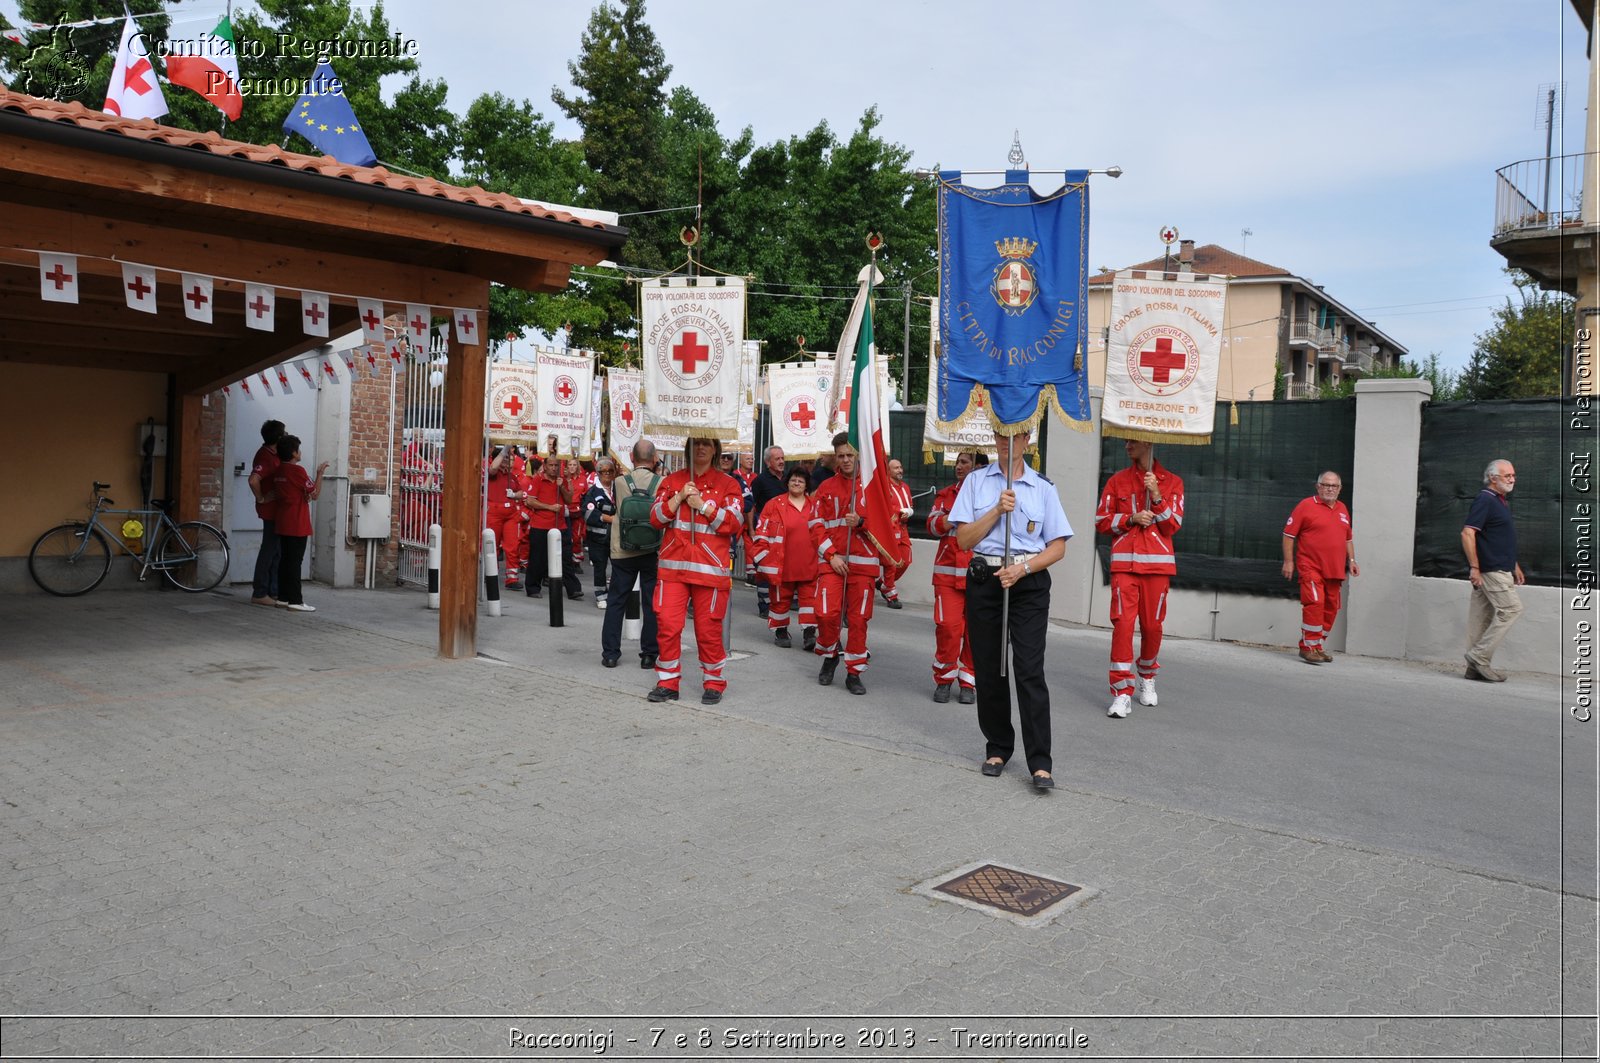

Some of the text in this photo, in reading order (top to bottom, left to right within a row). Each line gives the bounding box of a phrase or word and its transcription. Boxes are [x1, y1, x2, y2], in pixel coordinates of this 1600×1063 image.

[646, 292, 664, 301] CORPO
[696, 292, 706, 300] DEL
[708, 291, 739, 300] SOCCORSO
[1117, 284, 1221, 298] CORPO VOLONTARI DEL SOCCORSO
[648, 303, 735, 346] CROCE ROSSA ITALIANA
[1114, 302, 1218, 337] CROCE ROSSA ITALIANA
[989, 346, 1002, 360] DI
[1008, 300, 1075, 368] RACCONIGI
[667, 325, 675, 336] DI
[675, 317, 706, 328] GINEVRA
[706, 325, 717, 336] 22
[712, 338, 723, 371] AGOSTO
[1143, 331, 1151, 340] DI
[1151, 327, 1182, 338] GINEVRA
[1181, 335, 1191, 345] 22
[1188, 343, 1199, 374] AGOSTO
[658, 394, 723, 404] DELEGAZIONE DI
[672, 407, 707, 418] BARGE
[1119, 400, 1198, 414] DELEGAZIONE DI
[1128, 415, 1183, 429] PAESANA
